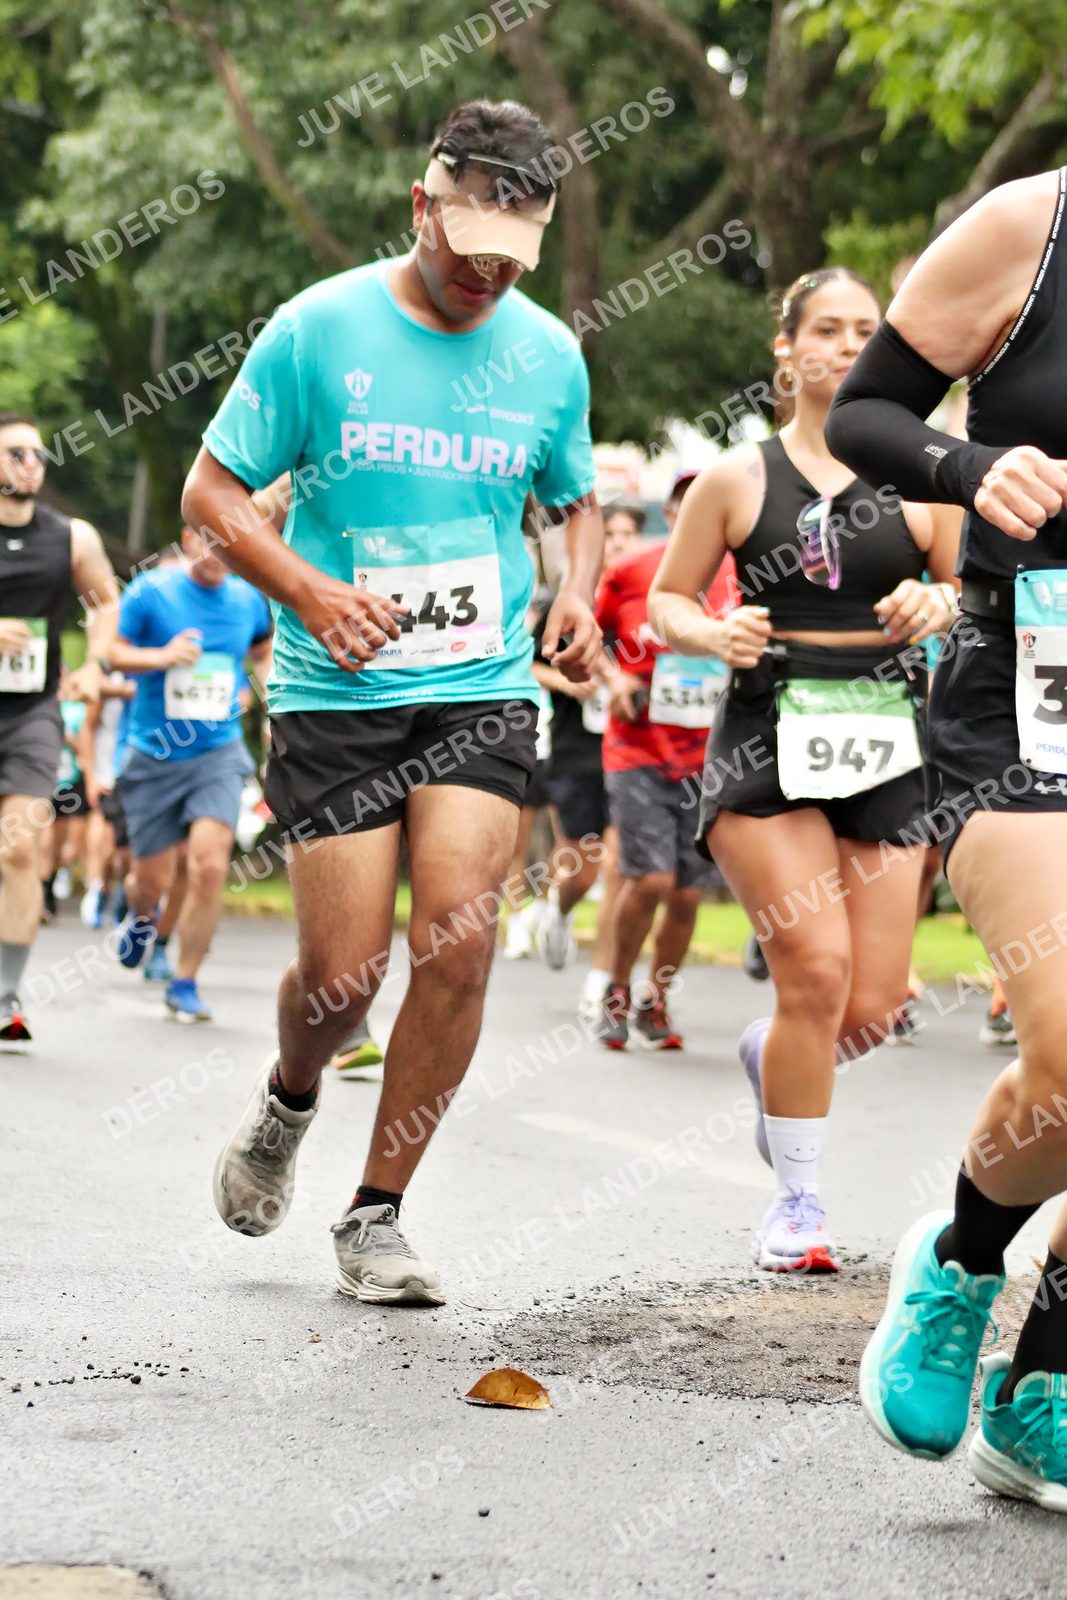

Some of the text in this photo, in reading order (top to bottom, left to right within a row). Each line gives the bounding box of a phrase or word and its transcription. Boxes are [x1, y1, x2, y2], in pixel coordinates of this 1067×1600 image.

[238, 381, 262, 410] OS
[489, 407, 535, 426] BROOKS
[340, 421, 527, 479] PERDURA
[1032, 665, 1067, 725] 3
[807, 736, 895, 774] 947
[377, 1206, 394, 1223] OKA
